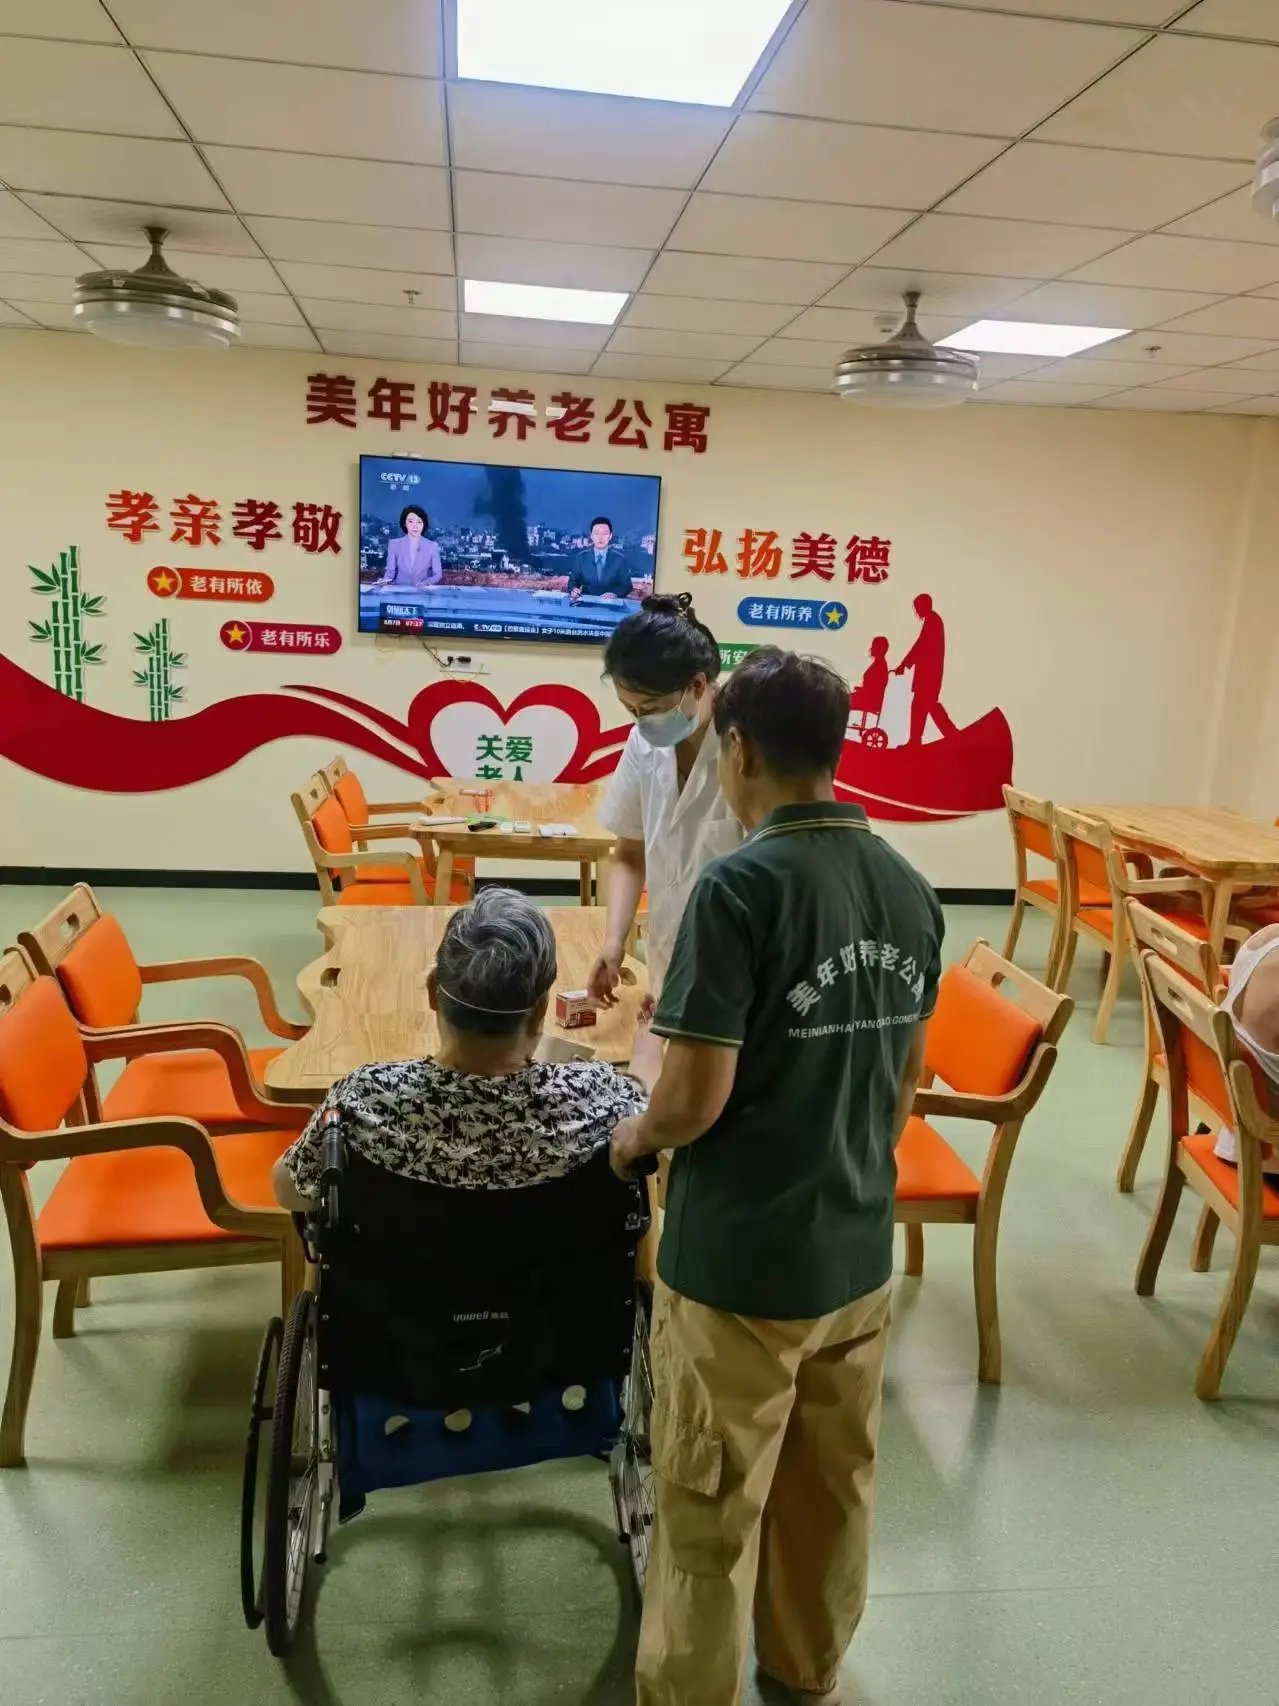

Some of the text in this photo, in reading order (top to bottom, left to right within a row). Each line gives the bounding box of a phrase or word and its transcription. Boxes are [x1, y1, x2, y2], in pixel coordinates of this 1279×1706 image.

[306, 373, 711, 454] 美年好养老公寓
[105, 489, 343, 554] 孝亲孝敬
[682, 528, 892, 584] 弘扬美德
[189, 575, 263, 595] 老有所依
[749, 603, 812, 622] 老有所养
[260, 629, 331, 648] 老有所乐
[719, 649, 748, 666] 所安
[476, 734, 533, 763] 关爱
